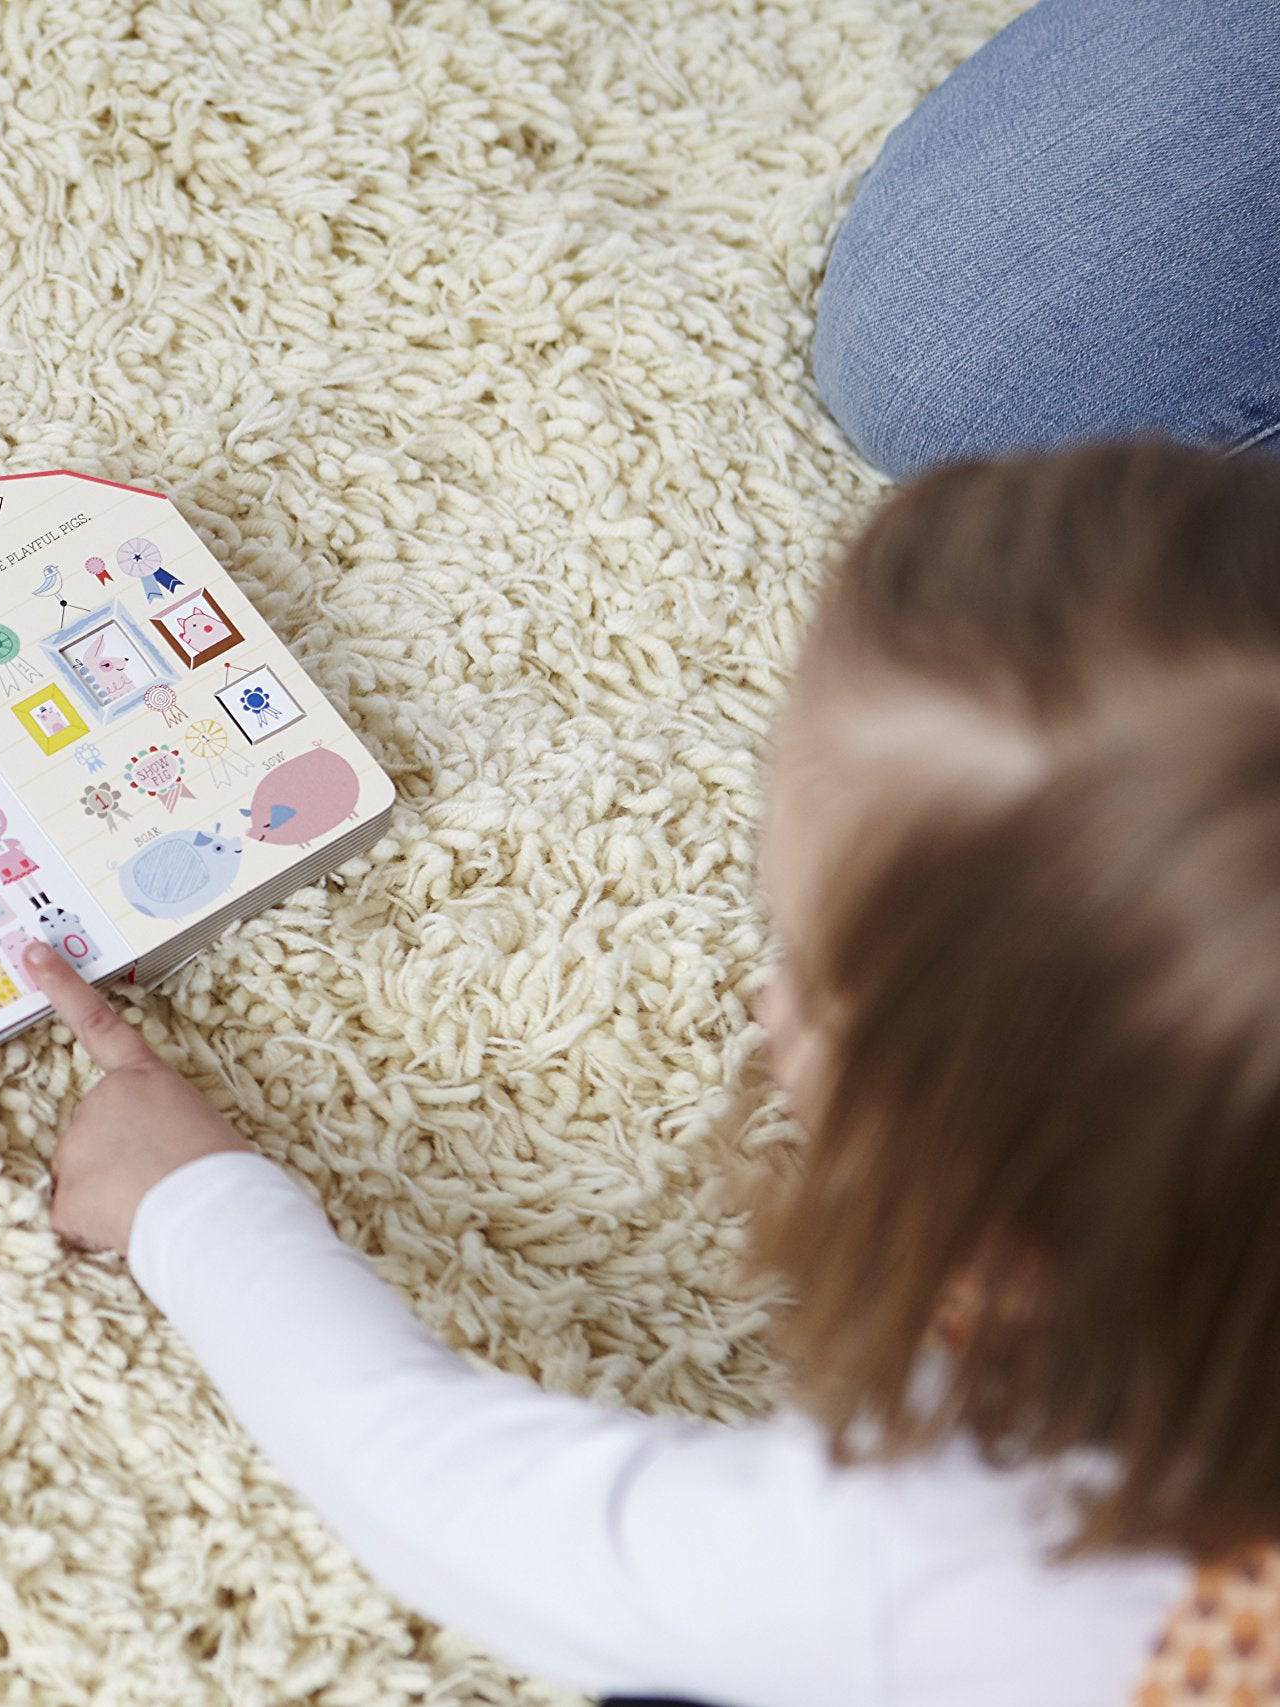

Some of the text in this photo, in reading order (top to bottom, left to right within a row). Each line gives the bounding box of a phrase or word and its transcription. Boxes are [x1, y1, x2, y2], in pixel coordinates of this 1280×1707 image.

[6, 531, 60, 566] PLAYFUL
[58, 513, 92, 536] PIGS.
[136, 755, 169, 781] SHOW
[261, 750, 286, 771] SOW
[151, 769, 172, 786] PIG
[95, 793, 109, 810] 1
[134, 826, 162, 848] BOAR
